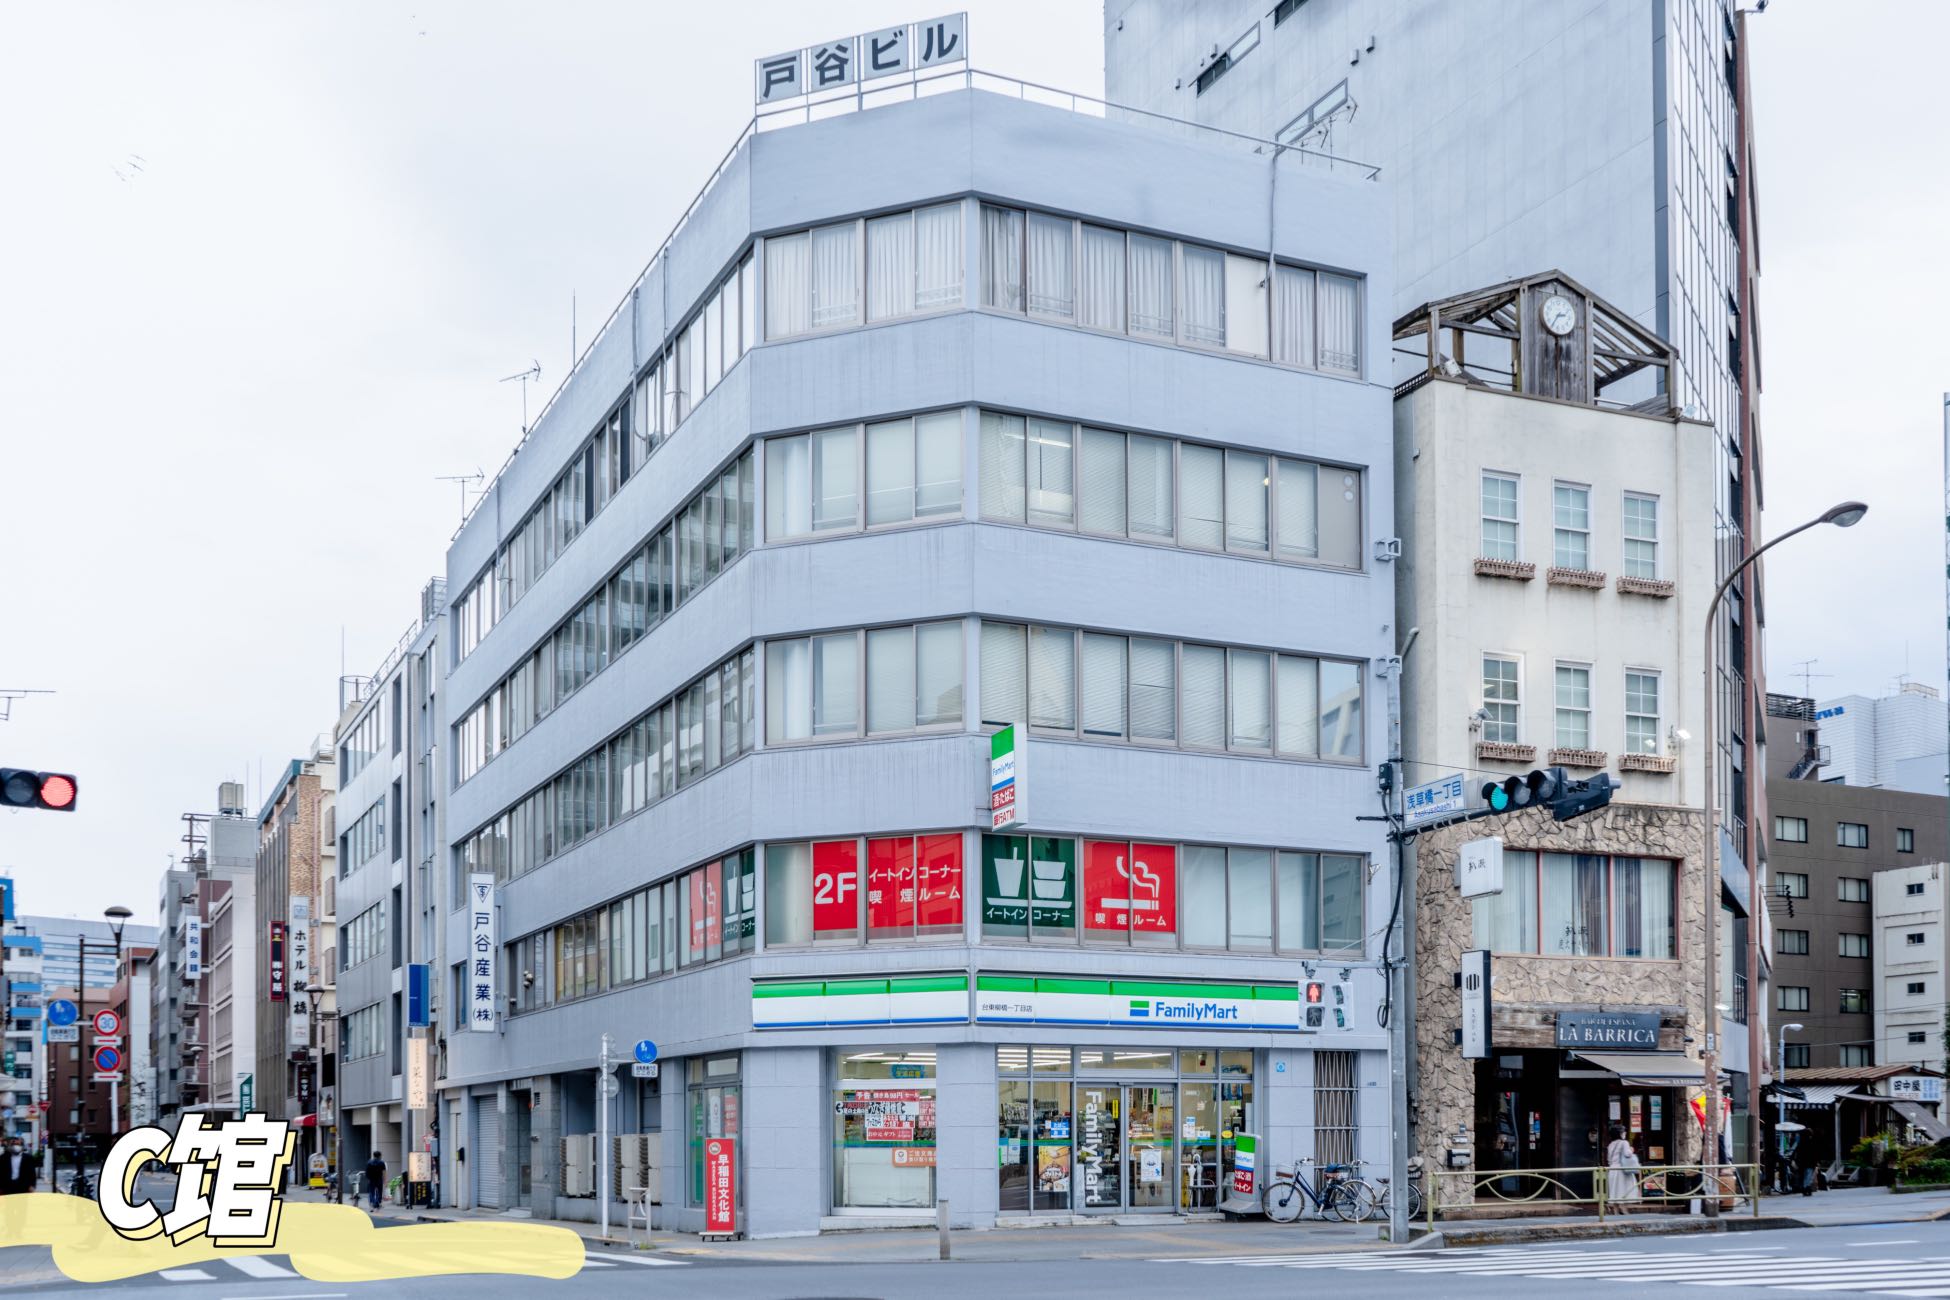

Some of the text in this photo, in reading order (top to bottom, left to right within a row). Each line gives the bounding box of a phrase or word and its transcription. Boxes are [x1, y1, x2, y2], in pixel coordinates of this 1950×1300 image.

[763, 24, 958, 98] 戸谷ビル
[1406, 780, 1461, 809] 浅草橋一丁目
[814, 872, 857, 905] 2F
[981, 1003, 1033, 1013] 台東柳橋一丁目店
[1155, 1001, 1239, 1021] FamilyMart
[100, 1017, 115, 1029] 30
[1559, 1027, 1655, 1043] LA BARRICA
[1082, 1091, 1103, 1203] FamilyMart
